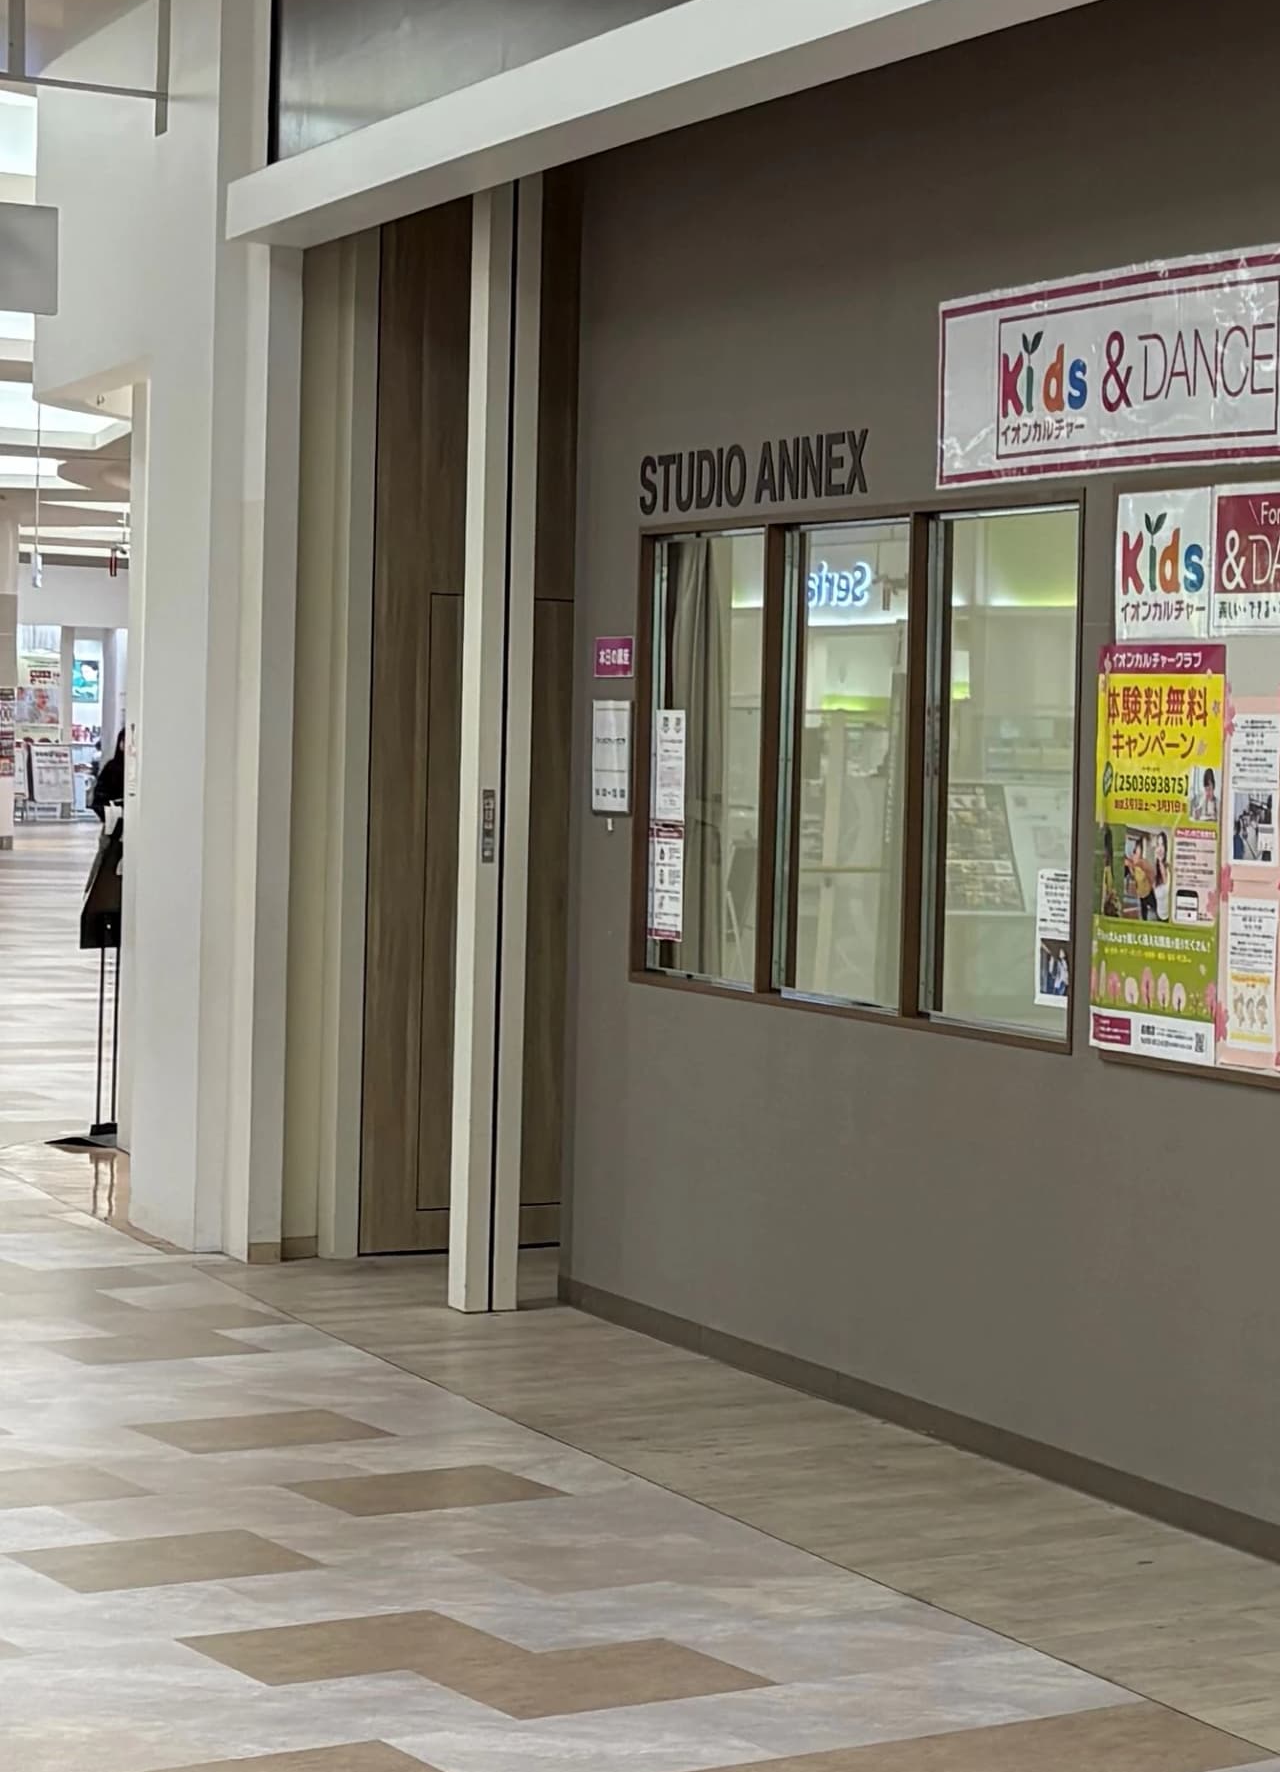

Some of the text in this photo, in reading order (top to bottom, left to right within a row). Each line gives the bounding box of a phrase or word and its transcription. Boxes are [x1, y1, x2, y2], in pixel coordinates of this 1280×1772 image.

[1001, 331, 1088, 419] Kids
[1137, 323, 1277, 401] DANCE
[1001, 417, 1085, 447] イオンカルチャー
[638, 428, 868, 516] STUDIO ANNEX
[1121, 512, 1205, 596] Kids
[1120, 599, 1206, 624] イオンカルチャー
[1112, 651, 1203, 669] イオンカルチャークラブ
[1107, 686, 1208, 727] 体験料無料
[1112, 729, 1195, 760] キャンペーン
